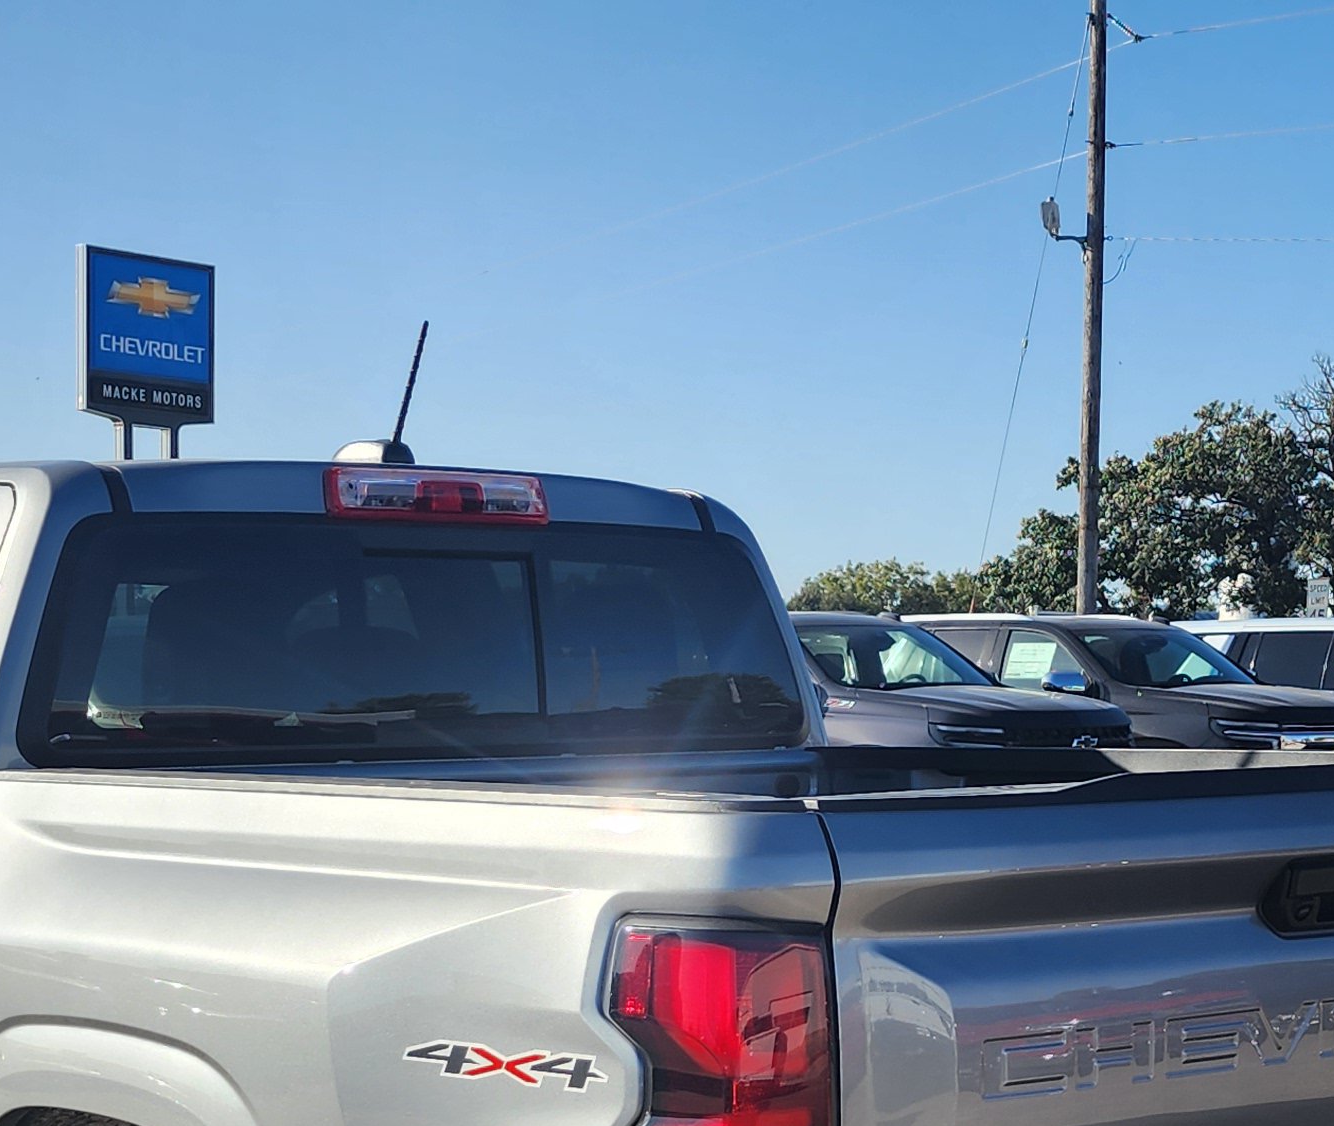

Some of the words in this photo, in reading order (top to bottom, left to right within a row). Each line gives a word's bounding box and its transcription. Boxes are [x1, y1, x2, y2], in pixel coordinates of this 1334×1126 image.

[100, 334, 205, 364] CHEVROLET
[102, 384, 146, 402] MACKE
[152, 390, 203, 409] MOTORS
[1310, 584, 1327, 592] SPEED
[1310, 597, 1325, 605] LIMIT
